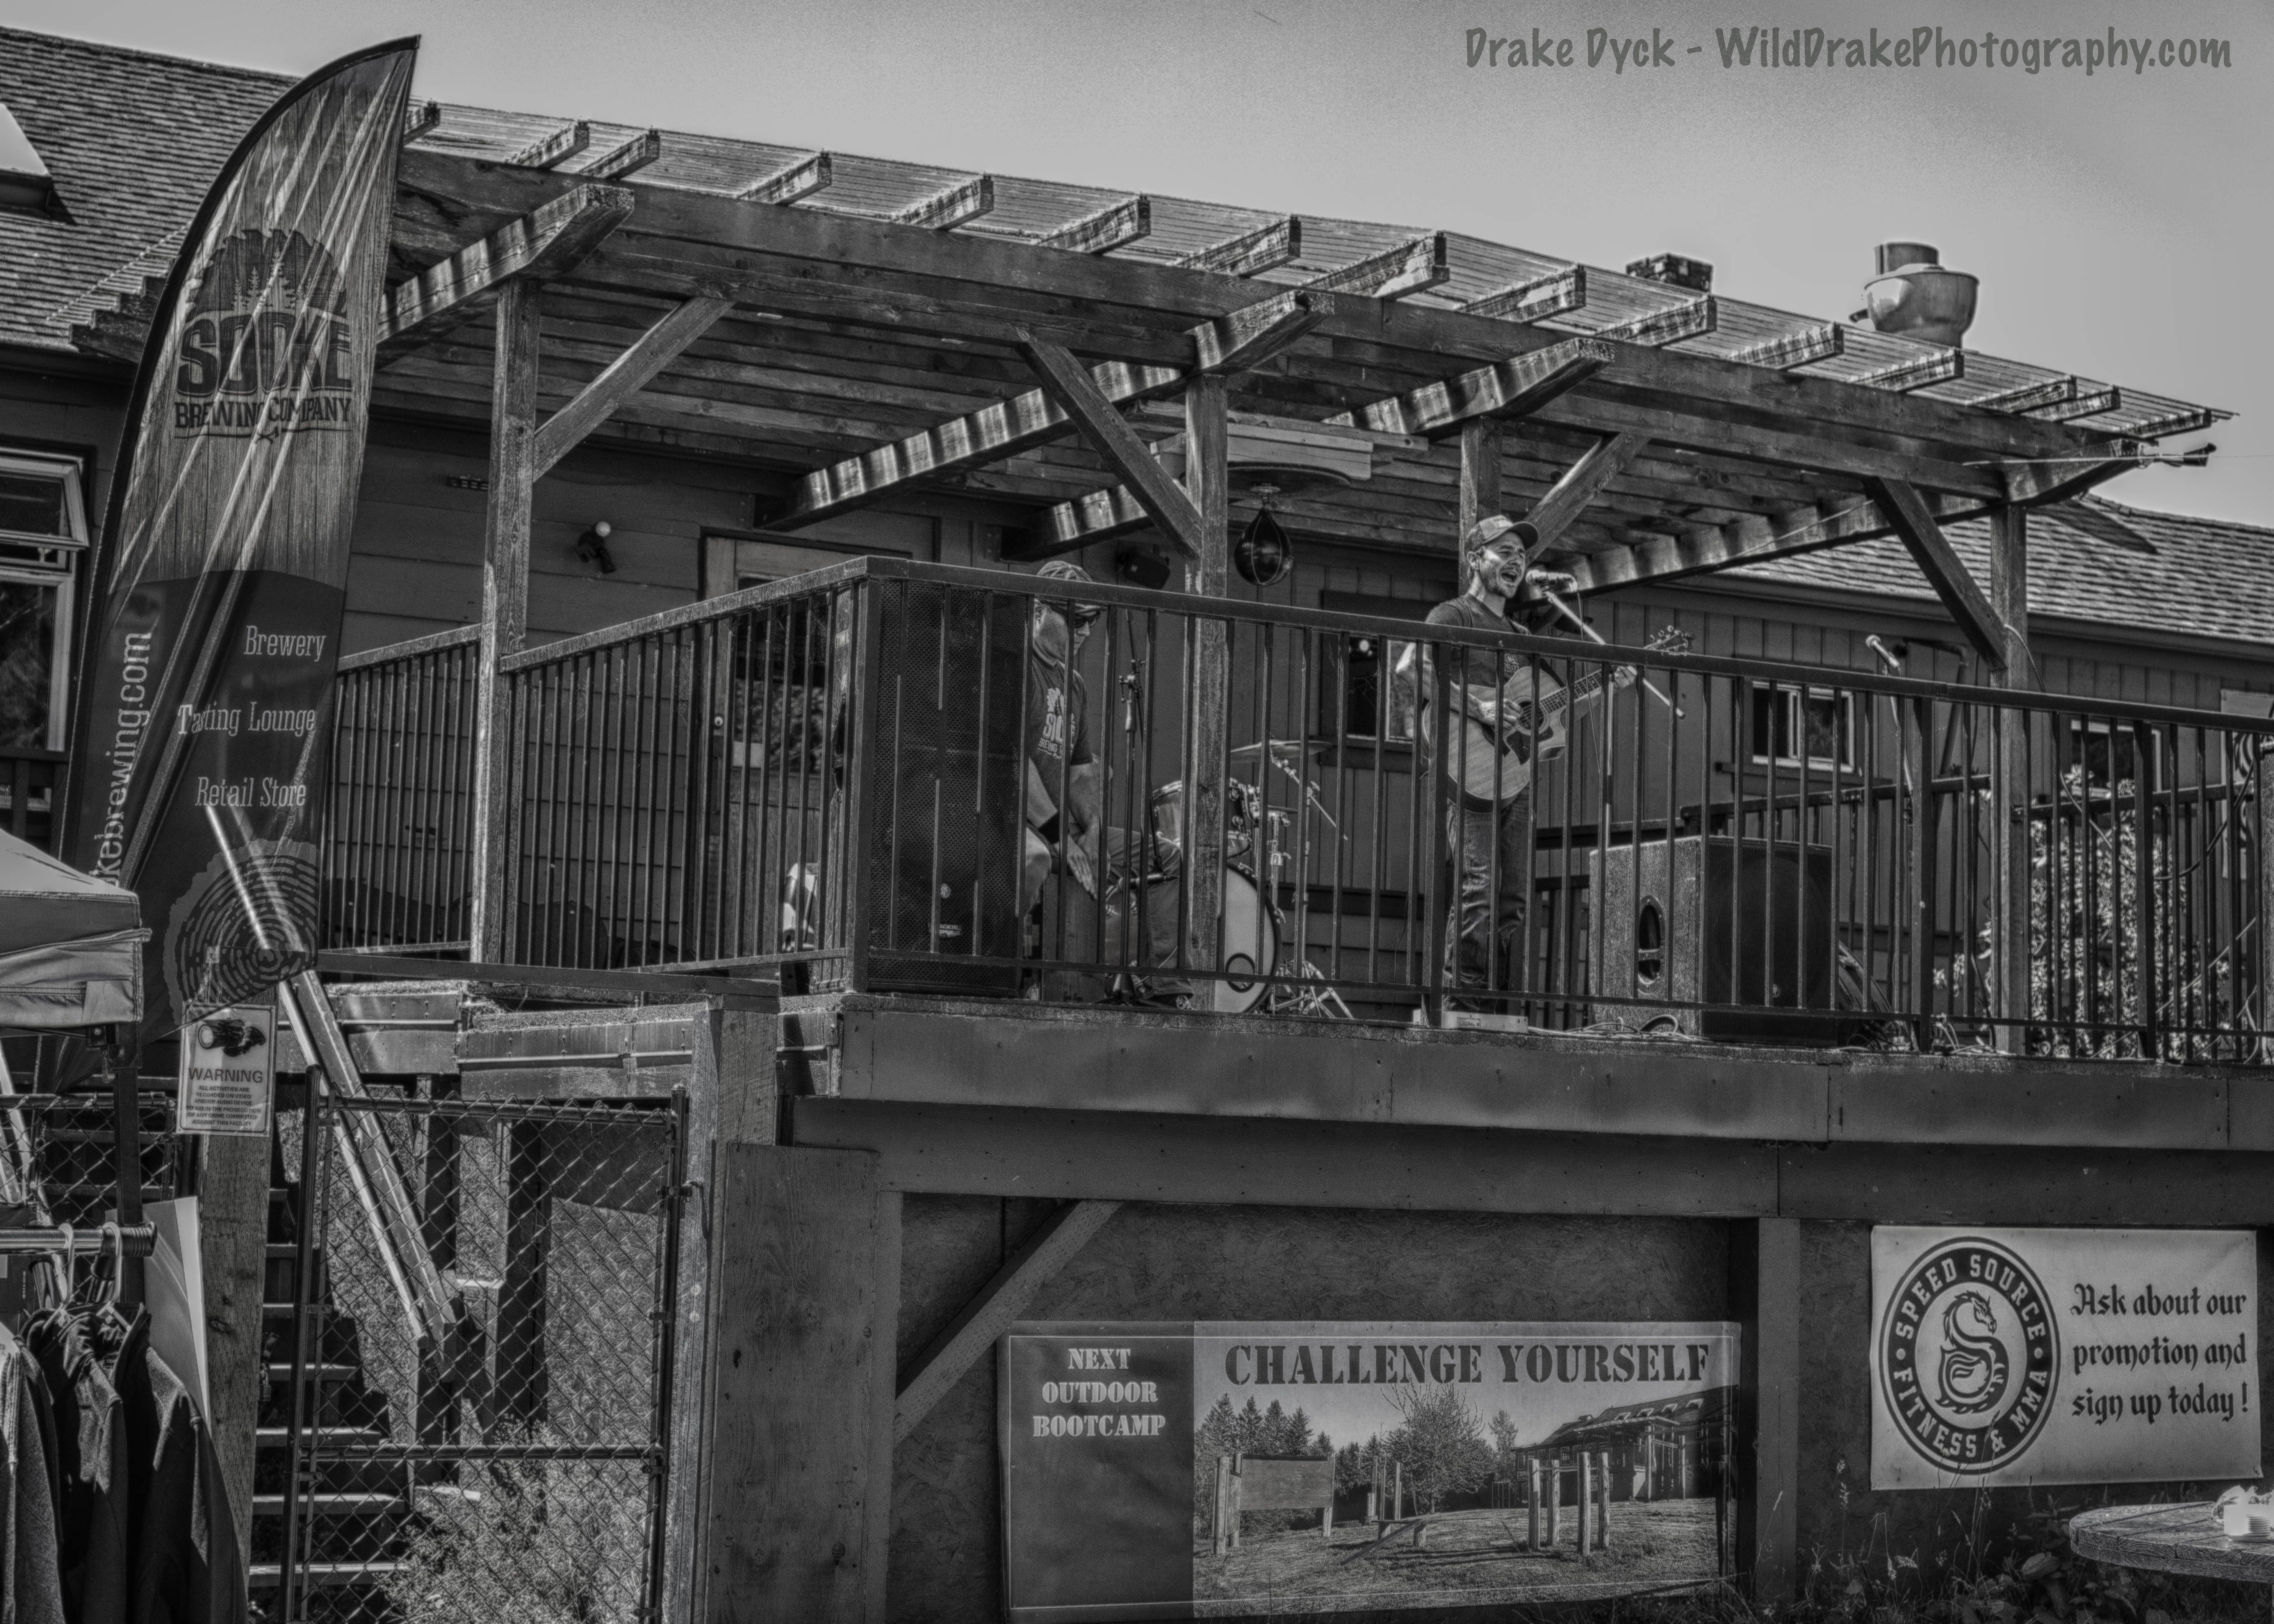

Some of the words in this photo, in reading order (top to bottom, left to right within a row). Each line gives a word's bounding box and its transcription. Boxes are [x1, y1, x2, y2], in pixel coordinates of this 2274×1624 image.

[268, 397, 351, 422] COMPANY
[244, 625, 326, 662] Brewery
[178, 701, 241, 737] Tasting
[248, 702, 315, 737] Lounge
[195, 777, 253, 807] Retail
[260, 777, 306, 807] Store
[188, 1068, 263, 1083] WARNING
[1896, 1259, 1957, 1340] SPEED
[1969, 1255, 2046, 1341] SOURCE
[2133, 1284, 2200, 1315] about
[2206, 1294, 2247, 1315] our
[1068, 1348, 1131, 1370] NEXT
[1225, 1344, 1482, 1385] CHALLENGE
[1497, 1344, 1709, 1382] YOURSELF
[2073, 1335, 2199, 1375] promotion
[2205, 1333, 2247, 1371] and
[1042, 1382, 1158, 1403] OUTDOOR
[2073, 1388, 2124, 1425] sign
[2130, 1393, 2162, 1425] up
[2168, 1382, 2235, 1422] today
[1033, 1415, 1166, 1437] BOOTCAMP
[1893, 1368, 1977, 1457] FITNESS
[1989, 1430, 2006, 1452] &
[2010, 1369, 2048, 1433] MMA
